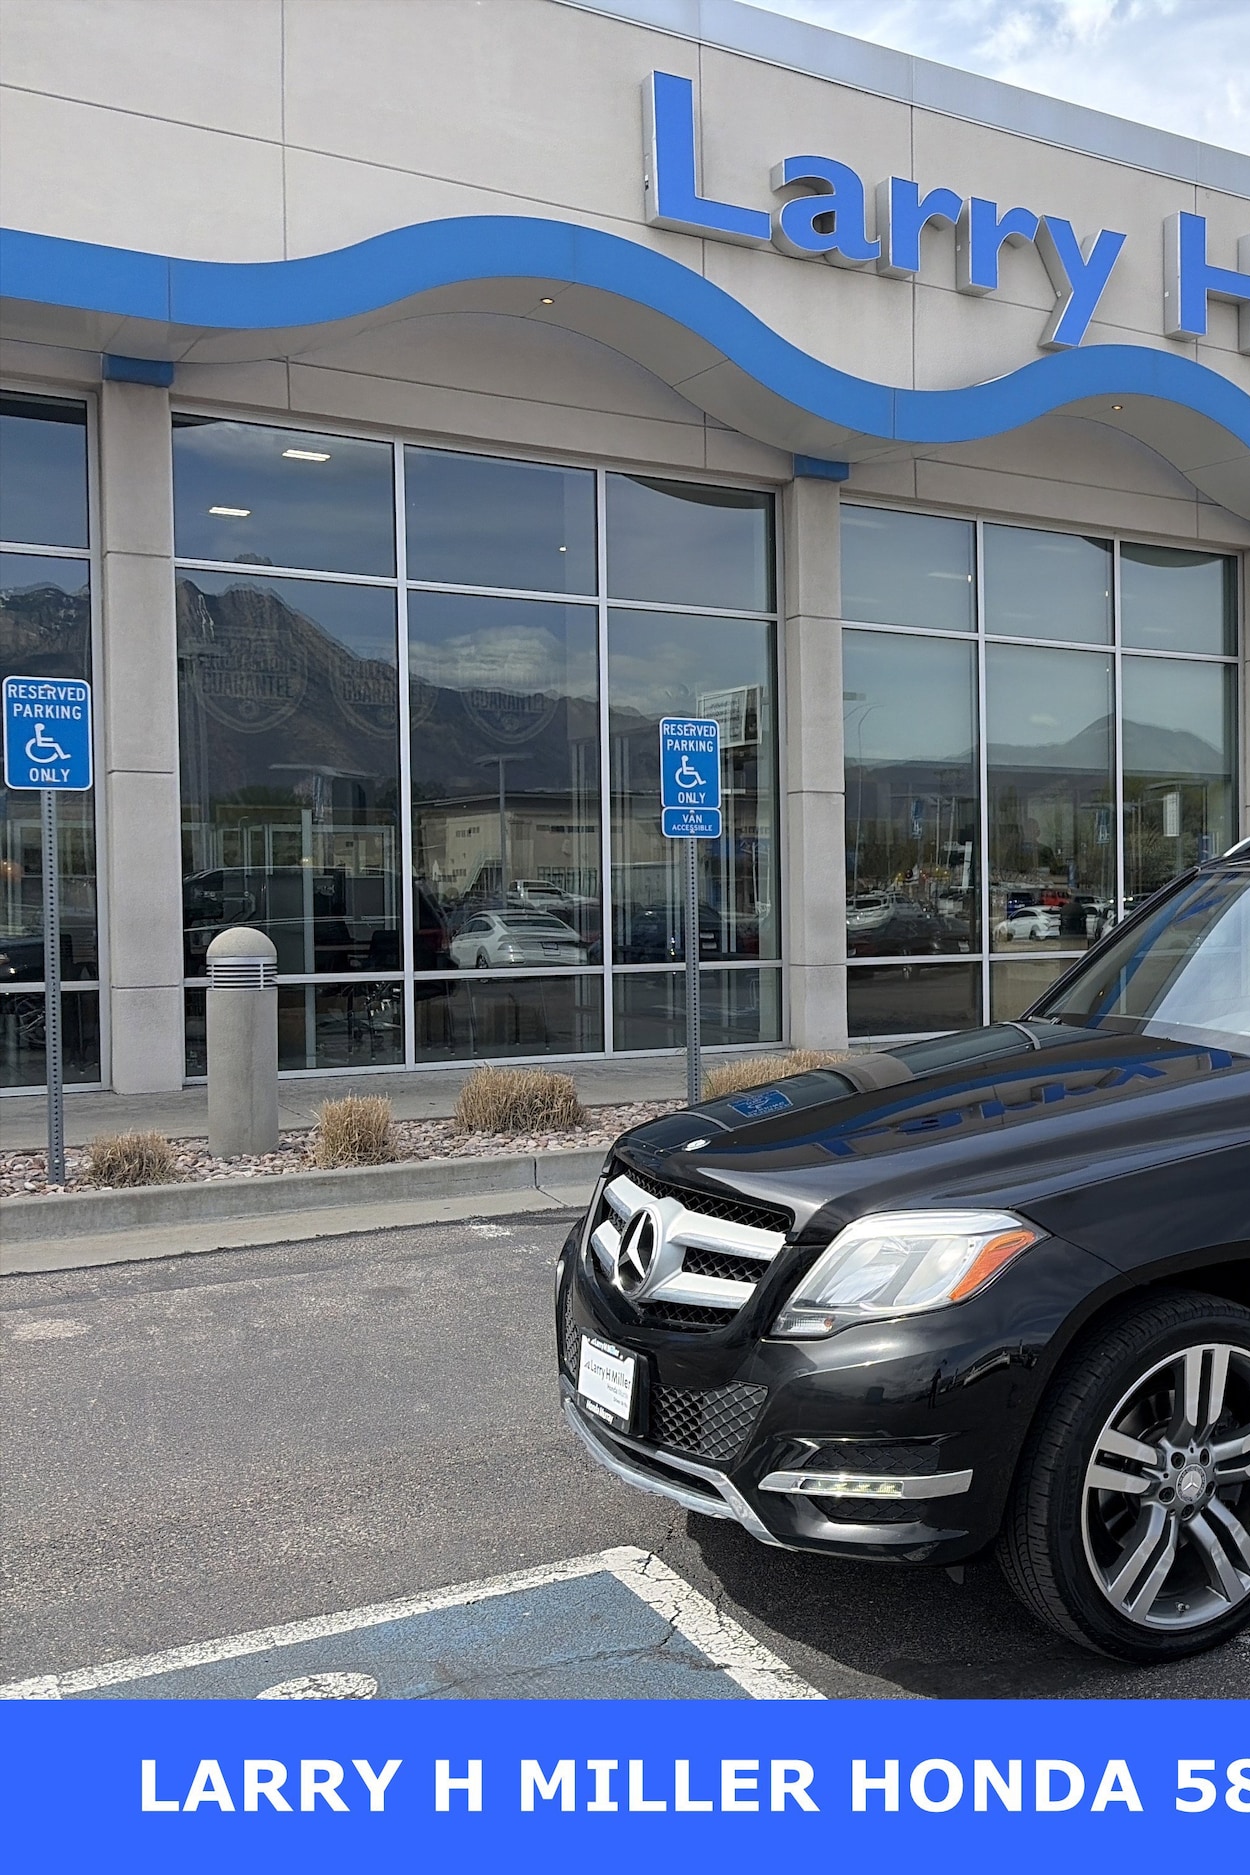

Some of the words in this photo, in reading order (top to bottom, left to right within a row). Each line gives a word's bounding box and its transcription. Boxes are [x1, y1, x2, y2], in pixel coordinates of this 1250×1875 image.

[643, 71, 1126, 350] Larry
[7, 684, 86, 702] RESERVED
[13, 703, 82, 720] PARKING
[663, 723, 716, 737] RESERVED
[666, 739, 713, 753] PARKING
[29, 767, 70, 783] ONLY
[677, 791, 706, 804] ONLY
[682, 814, 702, 824] VAN
[672, 824, 712, 833] ACCESSIBLE
[590, 1359, 606, 1381] Larry
[605, 1367, 611, 1381] H
[611, 1369, 631, 1390] Miller
